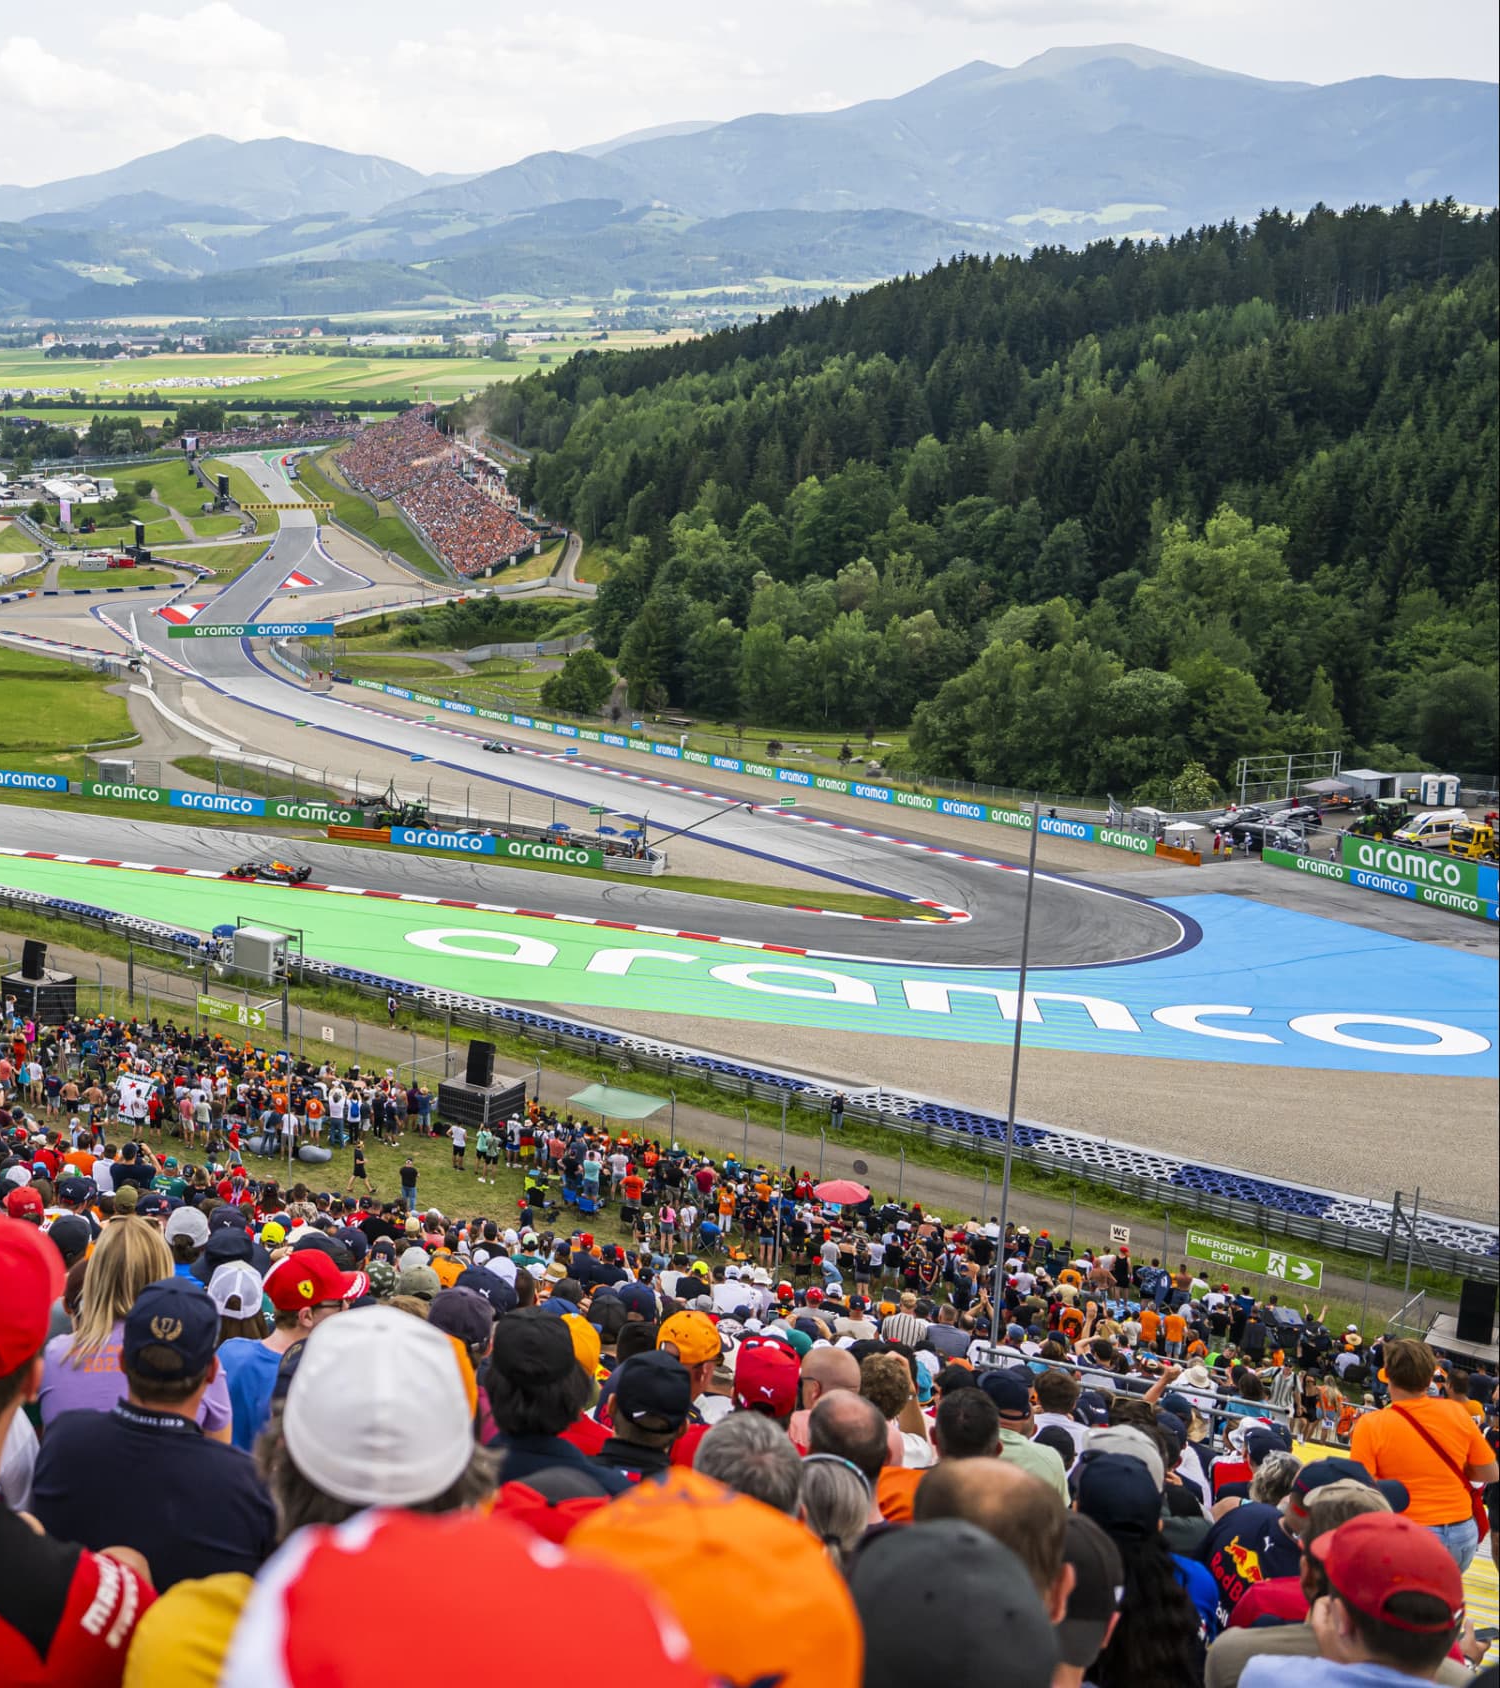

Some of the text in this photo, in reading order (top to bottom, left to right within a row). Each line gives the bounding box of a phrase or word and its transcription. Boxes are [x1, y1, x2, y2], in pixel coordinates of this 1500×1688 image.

[194, 625, 307, 637] aramco aramco
[445, 701, 471, 713] aramco
[479, 708, 508, 722] aramco
[655, 745, 678, 757] aramco
[684, 752, 707, 764] aramco
[714, 756, 739, 770] aramco
[746, 763, 772, 777] aramco
[780, 770, 809, 785] aramco
[816, 776, 847, 792] aramco
[92, 783, 159, 802] aramco
[856, 785, 888, 801] aramco
[181, 793, 252, 812] aramco
[898, 793, 932, 809] aramco
[276, 804, 351, 824] aramco
[943, 801, 980, 818] aramco
[991, 808, 1031, 827] aramco
[1041, 818, 1085, 838] aramco
[404, 830, 483, 850] aramco
[1100, 828, 1148, 852] aramco
[508, 842, 589, 864] aramco
[1359, 845, 1461, 887] aramco
[1297, 858, 1479, 913] aramco aramco aramco
[403, 928, 1492, 1055] aramco
[1113, 1226, 1128, 1238] WC
[1190, 1235, 1258, 1259] EMERGENCY
[1211, 1251, 1235, 1265] EXIT
